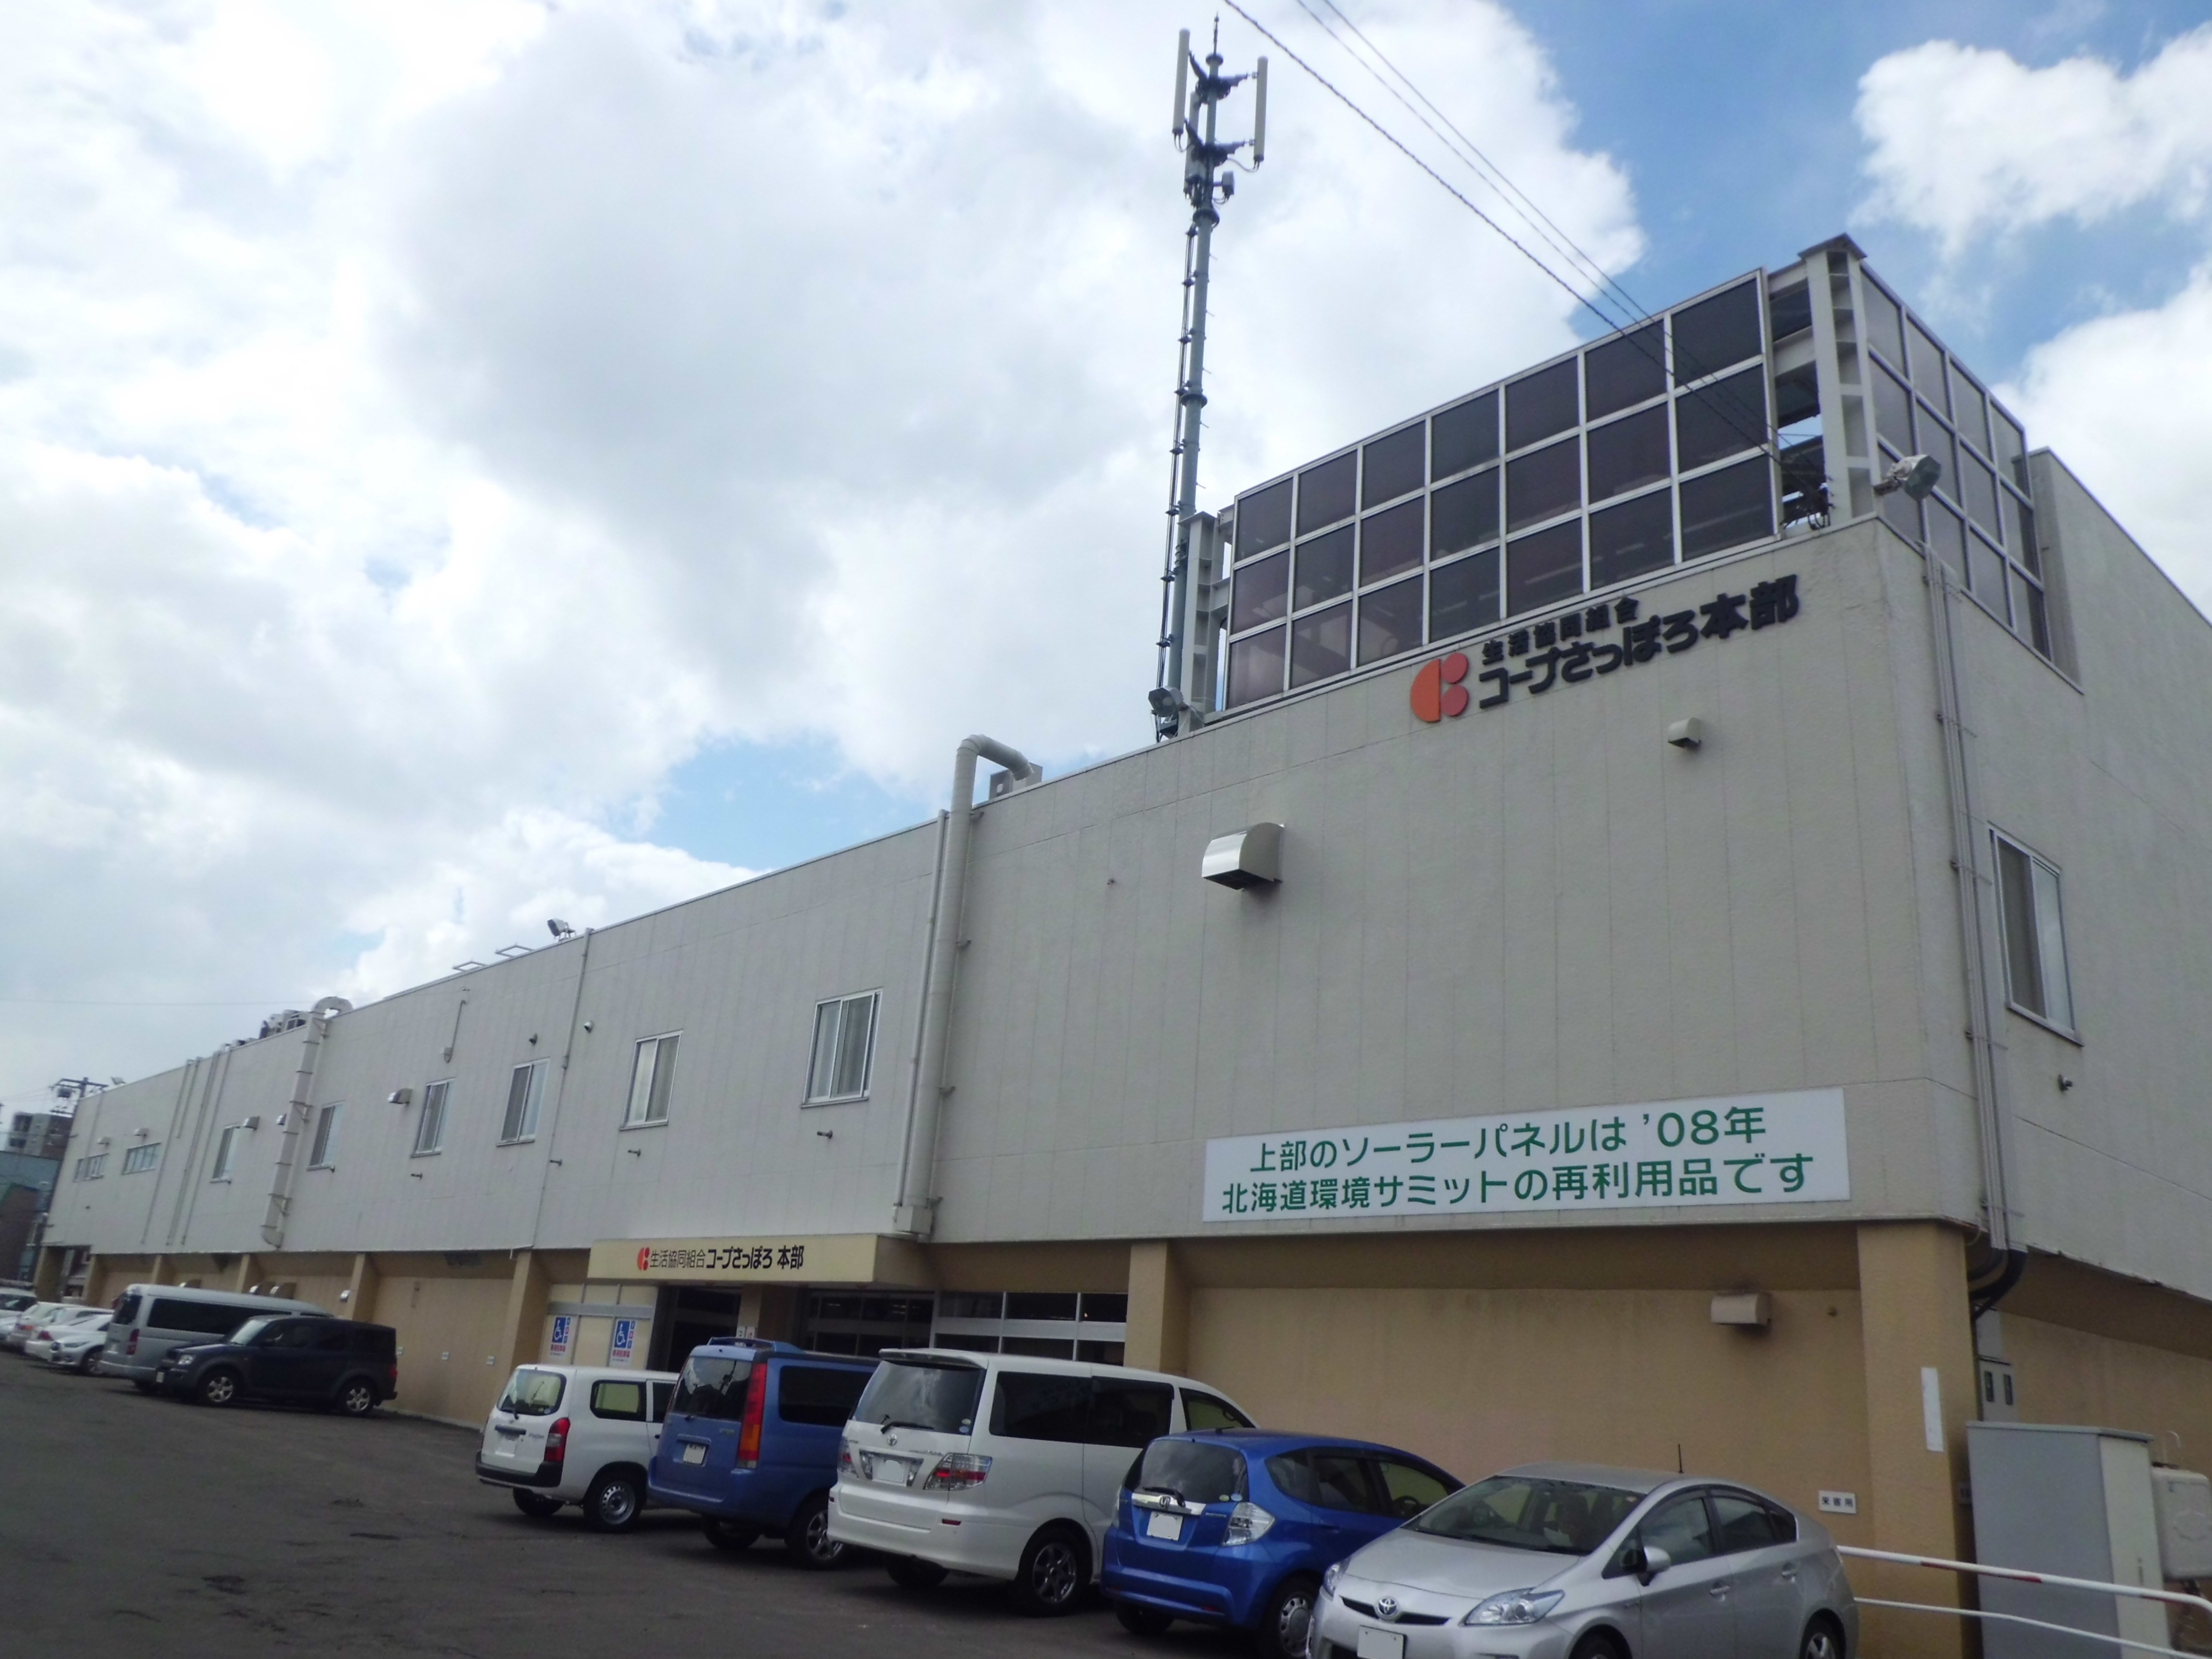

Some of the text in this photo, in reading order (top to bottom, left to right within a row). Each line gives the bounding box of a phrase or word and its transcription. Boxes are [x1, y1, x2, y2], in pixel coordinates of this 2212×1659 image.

[1222, 1153, 1814, 1214] 北海道環境サミットの再利用品です
